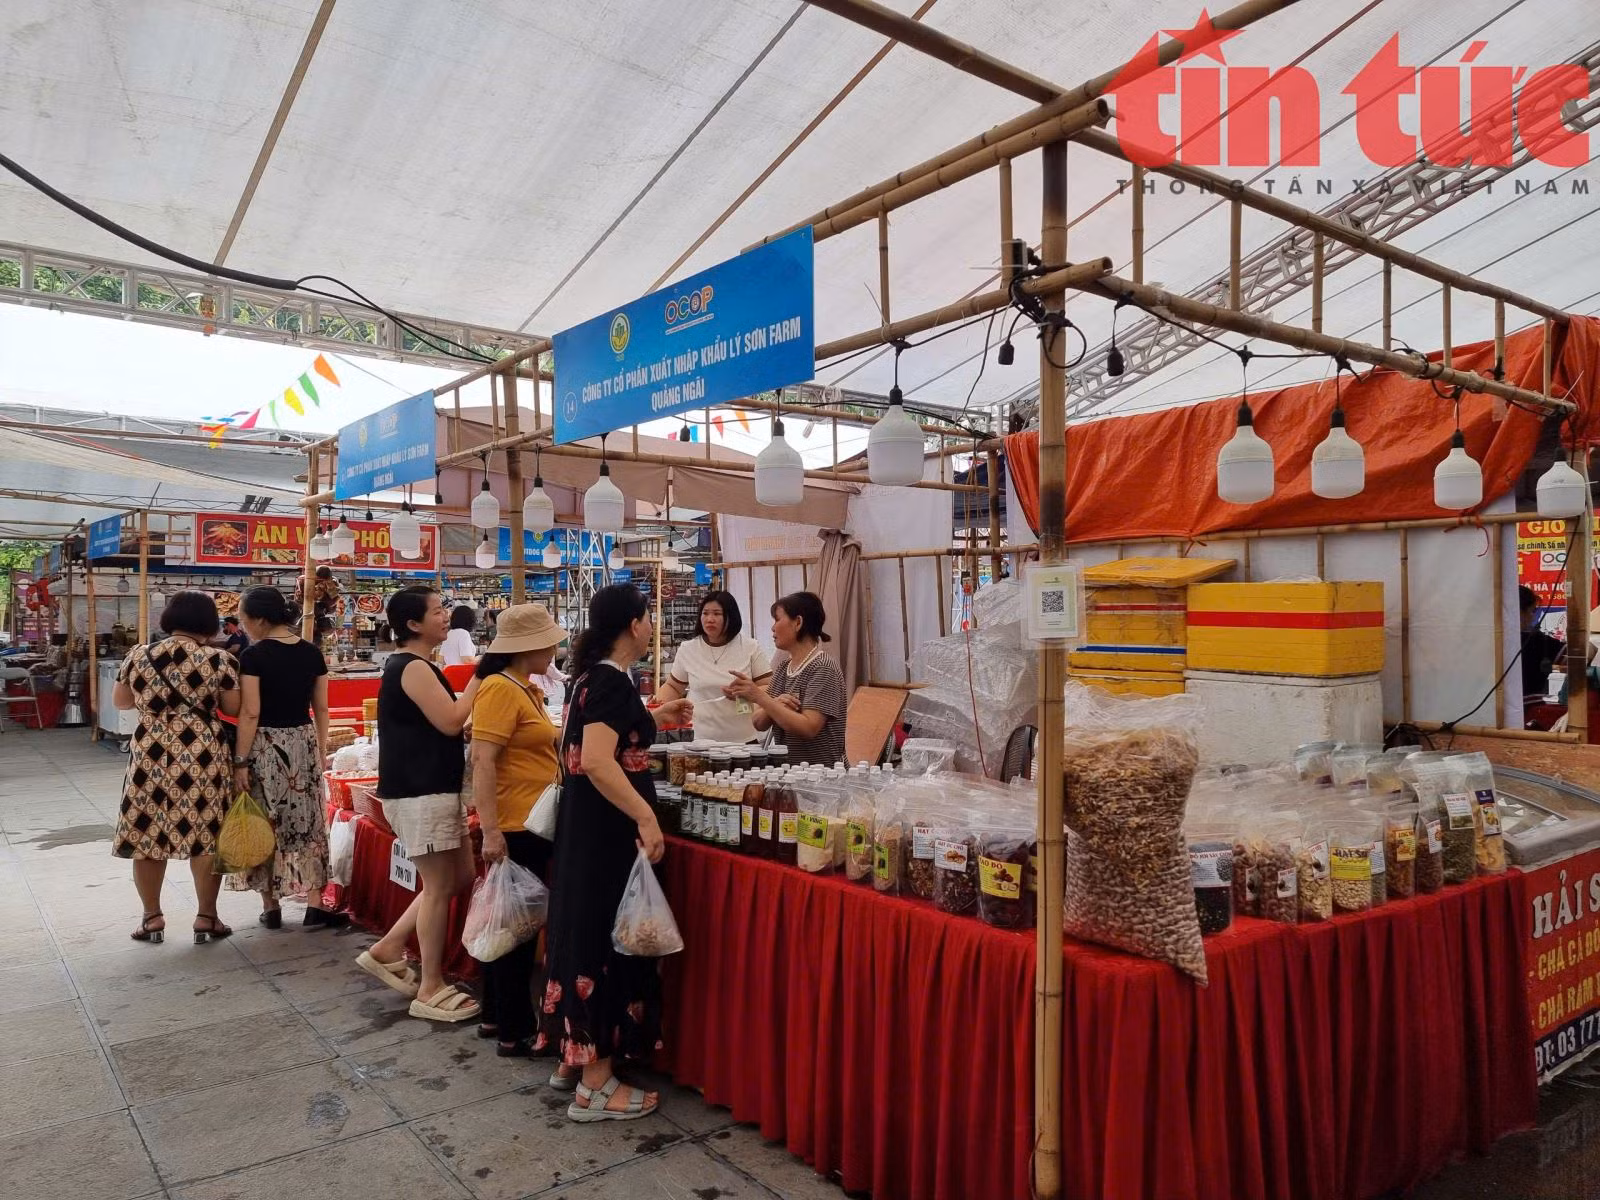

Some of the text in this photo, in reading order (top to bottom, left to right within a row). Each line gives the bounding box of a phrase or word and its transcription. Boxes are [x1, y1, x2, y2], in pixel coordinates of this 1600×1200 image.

[664, 285, 714, 325] OCOP
[582, 381, 602, 404] CÔNG
[603, 378, 612, 397] TY
[650, 354, 672, 383] XUẤT
[674, 349, 699, 376] NHẬP
[701, 335, 727, 368] KHẨU
[729, 332, 742, 359] LÝ
[744, 327, 767, 354] SƠN
[769, 316, 801, 347] FARM
[651, 375, 705, 413] QUẢNG NGÃI
[253, 520, 288, 545] ĂN
[1533, 869, 1584, 939] HẢI
[1557, 1026, 1576, 1058] 03
